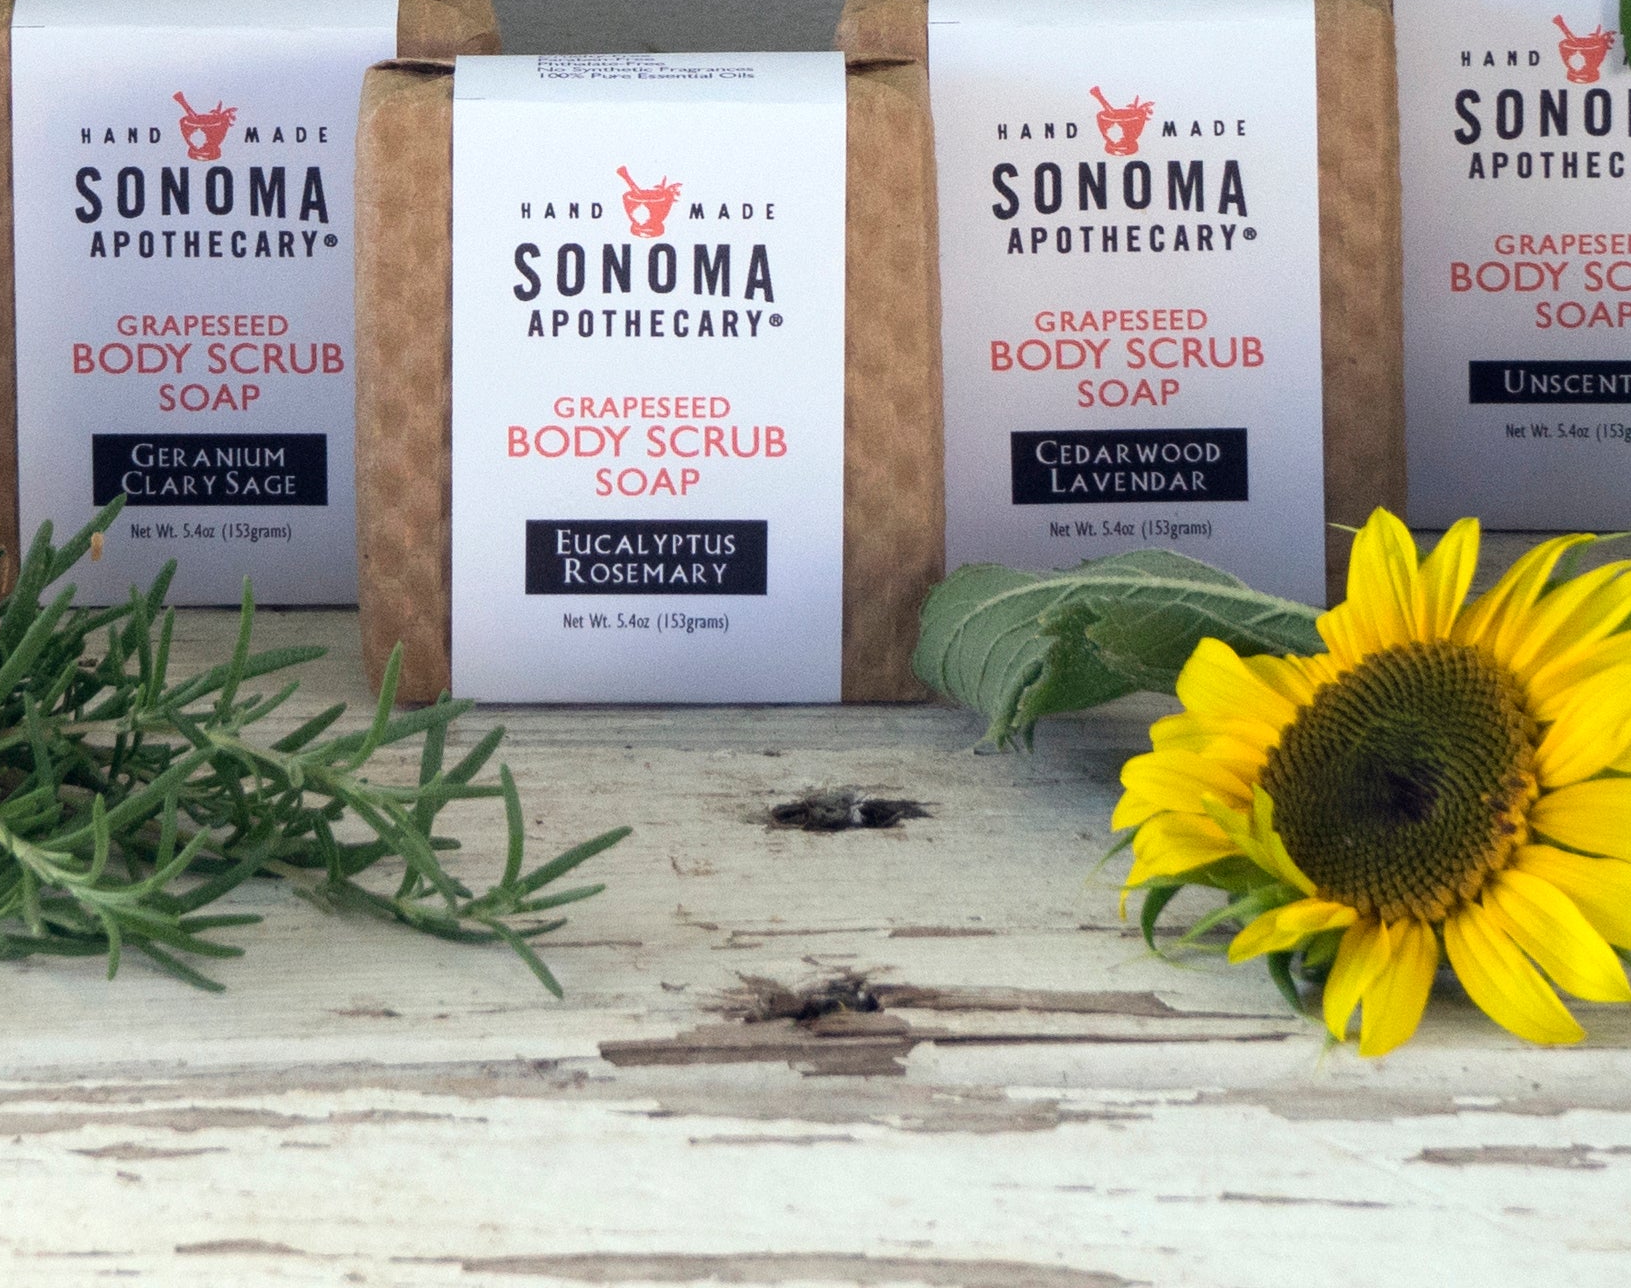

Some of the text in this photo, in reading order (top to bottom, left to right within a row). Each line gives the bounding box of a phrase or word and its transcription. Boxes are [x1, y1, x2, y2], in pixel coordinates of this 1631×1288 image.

[1461, 51, 1540, 66] HAND
[81, 127, 327, 143] HAND MADE
[998, 120, 1245, 139] HAND MADE
[76, 167, 328, 223] SONOMA
[993, 160, 1247, 220] SONOMA
[521, 203, 774, 219] HAND MADE
[514, 243, 774, 302] SONOMA
[1451, 262, 1567, 292] BODY
[118, 315, 288, 336] GRAPESEED
[1035, 309, 1207, 332] GRAPESEED
[74, 343, 344, 374] BODY SCRUB
[991, 337, 1264, 371] BODY SCRUB
[160, 384, 259, 411] SOAP
[1078, 379, 1179, 407] SOAP
[554, 397, 730, 418] GRAPESEED
[509, 426, 787, 458] BODY SCRUB
[1506, 425, 1525, 438] Net
[1531, 424, 1551, 439] Wt.
[1558, 423, 1589, 438] 5.4oz
[131, 443, 284, 467] GERANIUM
[1036, 441, 1220, 464] CEDARWOOD
[121, 471, 295, 496] CLARY SAGE
[597, 468, 699, 496] SOAP
[1052, 468, 1206, 492] LAVENDAR
[131, 523, 291, 543] Net Wt. 5.4oz (153grams)
[557, 530, 735, 554] EUCALYPTUS
[1050, 520, 1212, 540] Net Wt. 5.4oz (153grams)
[565, 558, 726, 583] ROSEMARY
[564, 613, 729, 633] Net Wt. 5.4oz (153grams)
